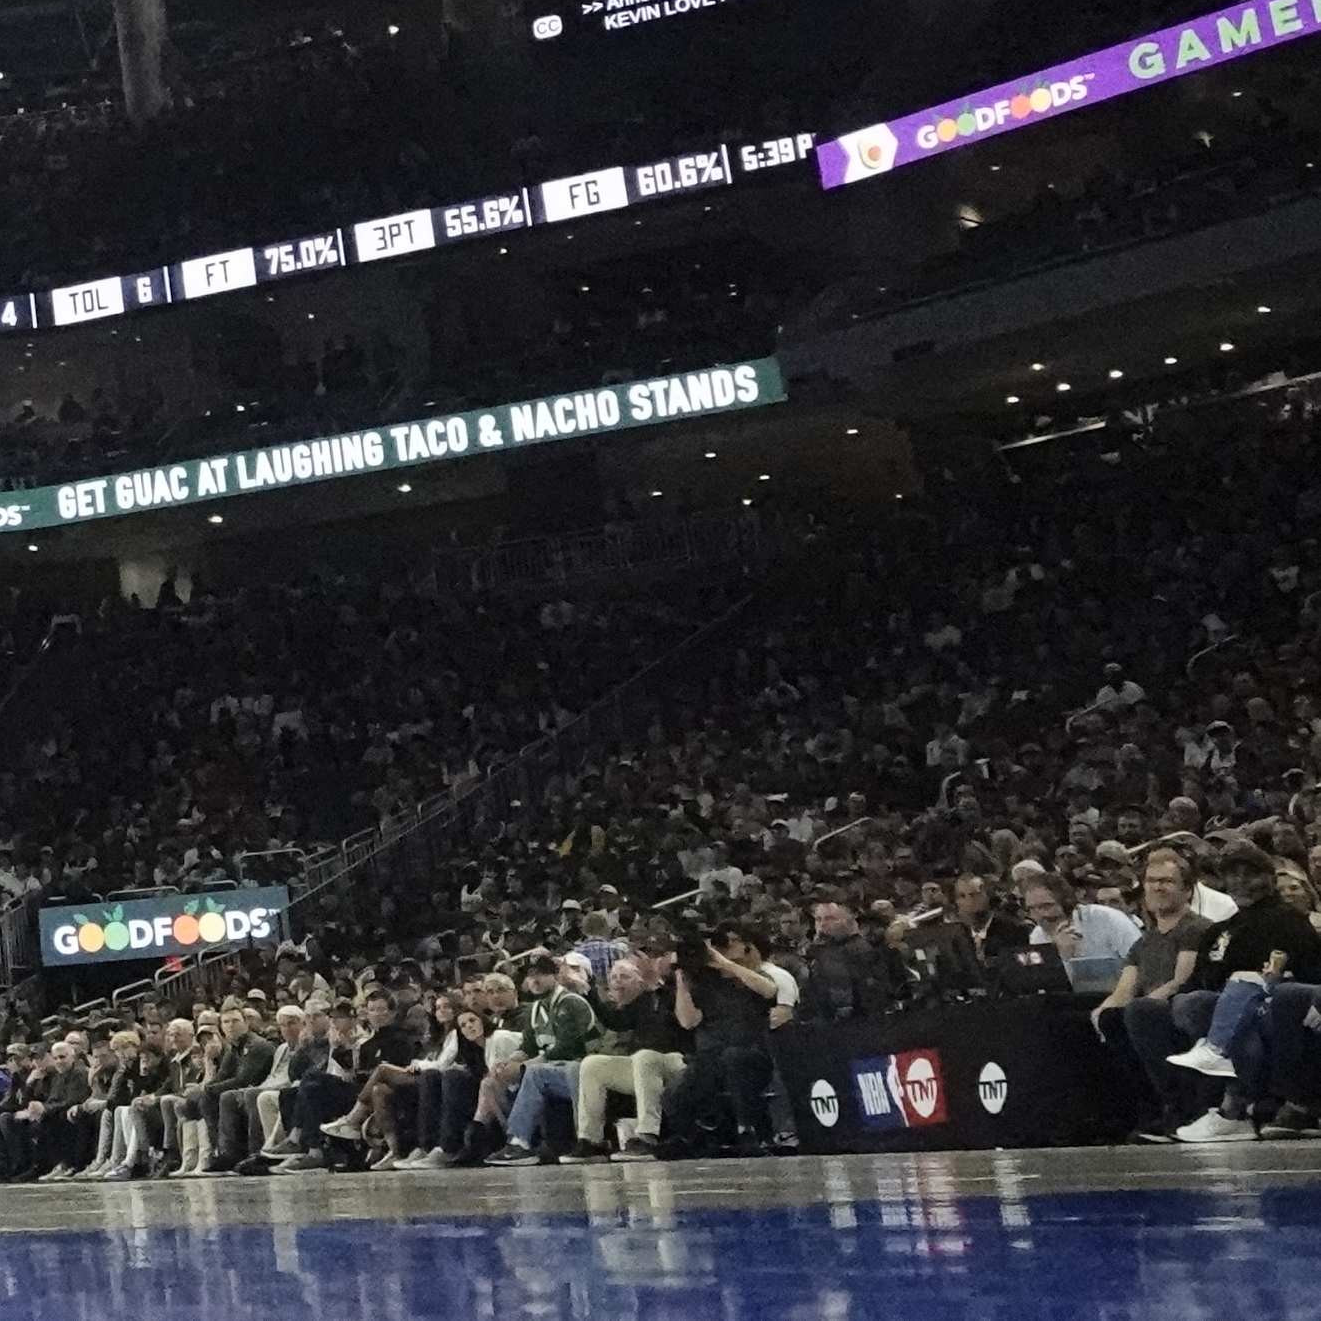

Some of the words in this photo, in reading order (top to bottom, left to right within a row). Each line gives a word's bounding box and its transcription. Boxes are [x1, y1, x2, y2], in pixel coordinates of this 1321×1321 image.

[534, 17, 561, 37] CC
[604, 2, 660, 30] KEVIN
[1, 301, 18, 327] 4
[68, 286, 109, 315] TOL
[136, 277, 153, 303] 6
[205, 260, 231, 287] FT
[264, 236, 337, 275] 75.0%
[373, 220, 416, 251] 3PT
[444, 195, 523, 237] 55.6%
[568, 180, 601, 209] FG
[636, 152, 723, 196] 60.6%
[741, 138, 796, 171] 5:39
[797, 132, 816, 159] P
[58, 480, 109, 519] GET
[115, 466, 189, 509] GUAC
[197, 458, 228, 496] AT
[236, 431, 384, 489] LAUGHING
[390, 416, 468, 461] TACO
[478, 414, 503, 447] &
[510, 390, 620, 442] NACHO
[629, 365, 759, 421] STANDS
[906, 1077, 937, 1103] TNT
[978, 1079, 1008, 1100] TNT
[811, 1096, 838, 1115] TNT
